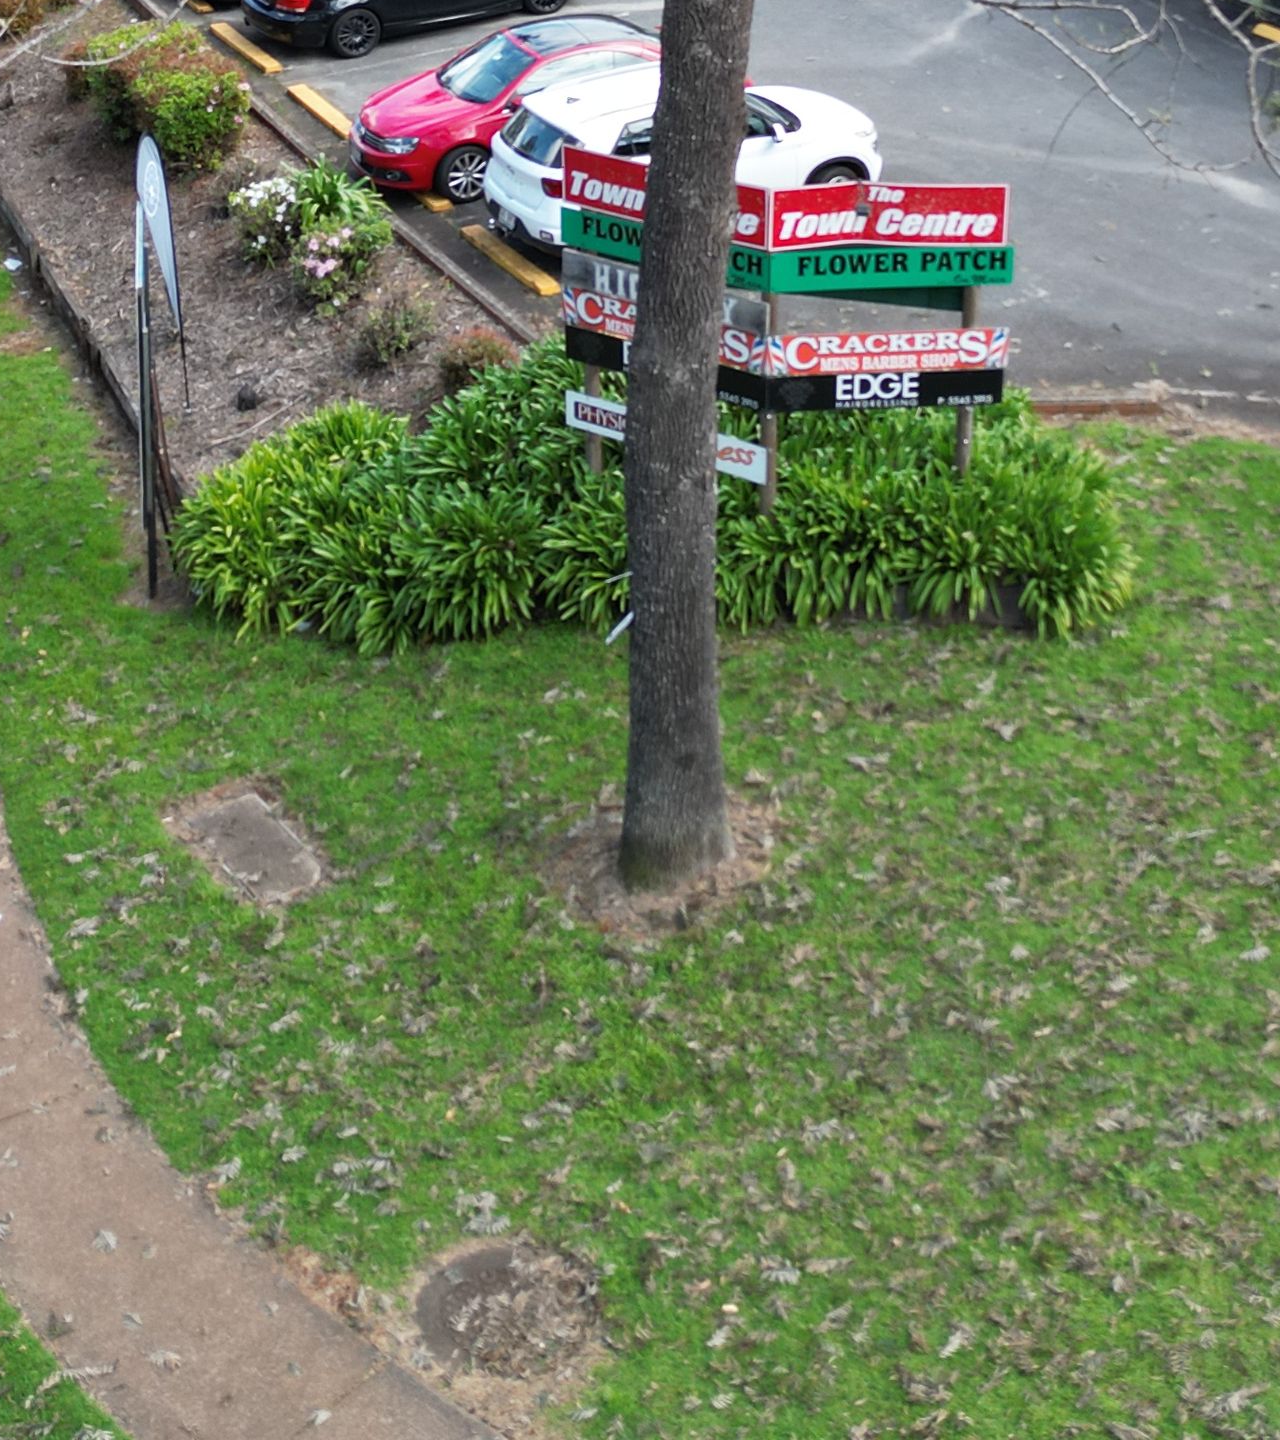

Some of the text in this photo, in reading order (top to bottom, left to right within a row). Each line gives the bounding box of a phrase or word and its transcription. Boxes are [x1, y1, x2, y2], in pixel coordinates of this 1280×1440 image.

[570, 170, 646, 211] Town
[868, 186, 905, 203] The
[582, 216, 641, 247] FLOW
[779, 210, 869, 240] Town
[875, 208, 998, 237] Centre
[798, 250, 1007, 276] FLOWER PATCH
[785, 330, 988, 371] CRACKERS
[820, 352, 958, 372] MENS BARBER SHOP
[835, 372, 919, 401] EDGE
